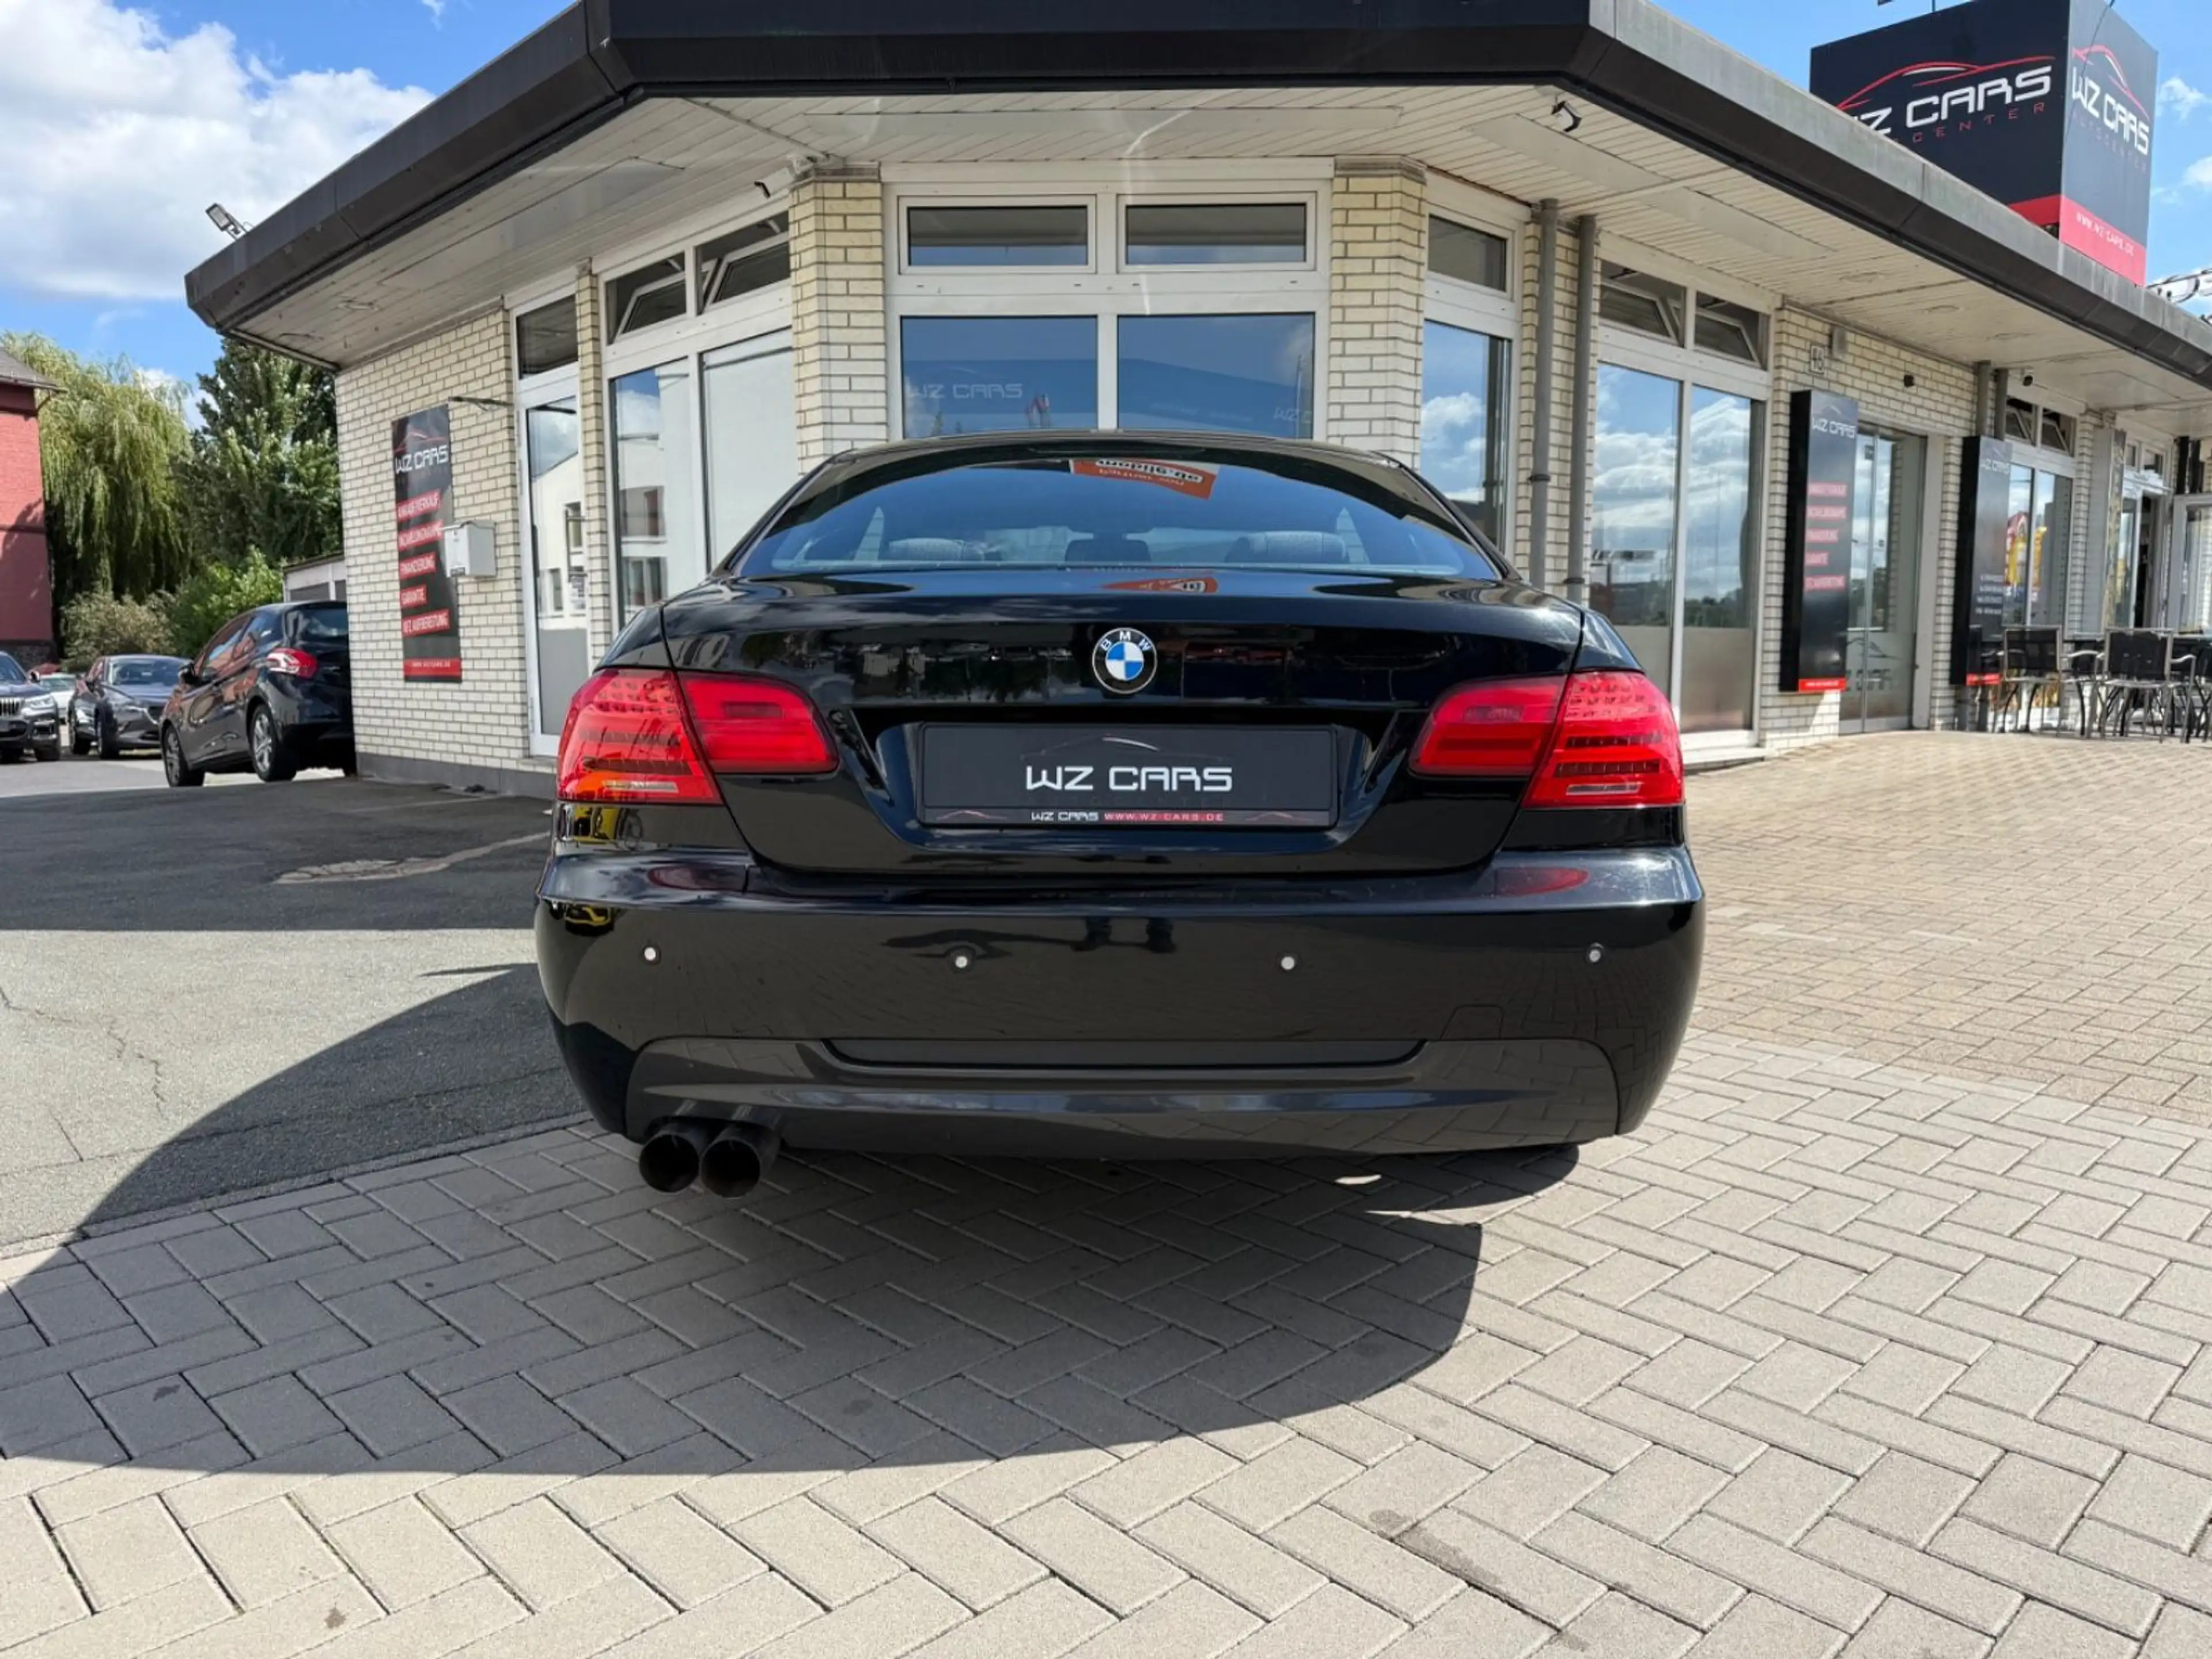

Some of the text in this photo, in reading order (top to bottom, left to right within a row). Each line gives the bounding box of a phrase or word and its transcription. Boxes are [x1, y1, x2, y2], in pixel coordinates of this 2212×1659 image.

[1854, 66, 2052, 134] Z CARS
[2072, 66, 2100, 118] WZ
[2104, 93, 2149, 155] CARS
[953, 383, 1023, 399] CARS
[395, 445, 449, 475] WZ CARS
[1100, 630, 1152, 651] BMW
[1027, 766, 1233, 791] WZ CARS
[1032, 812, 1054, 821] WZ
[1058, 812, 1099, 821] CARS
